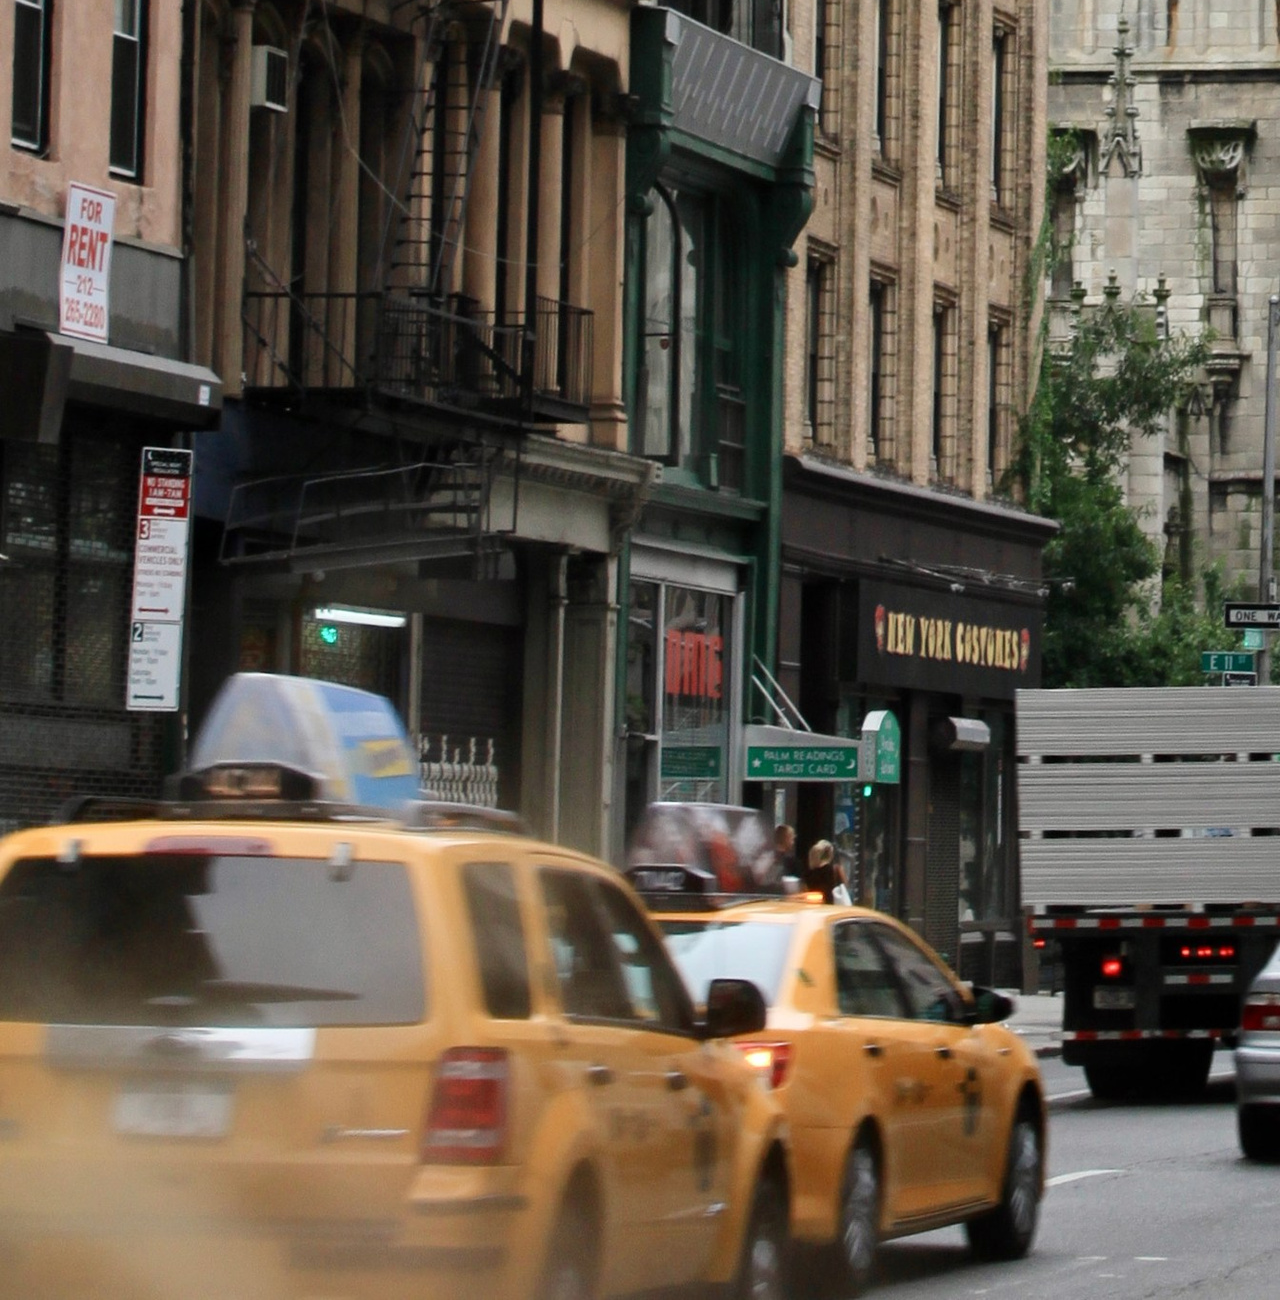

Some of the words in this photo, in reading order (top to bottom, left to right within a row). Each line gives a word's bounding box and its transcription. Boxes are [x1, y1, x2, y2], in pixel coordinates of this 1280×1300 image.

[80, 198, 103, 224] FOR
[67, 223, 108, 273] RENT
[76, 275, 93, 296] 212
[147, 477, 156, 487] NO
[157, 478, 185, 489] STANDING
[140, 520, 149, 539] 3
[139, 545, 177, 554] COMMERCIAL
[139, 556, 166, 565] VEHICLES
[168, 557, 183, 566] ONLY
[1236, 611, 1257, 622] ONE
[133, 623, 142, 641] 2
[887, 611, 915, 656] NEW
[918, 616, 952, 662] YORK
[955, 622, 1019, 670] COSTUMES
[1210, 655, 1218, 670] E
[1224, 655, 1233, 670] 11
[764, 750, 790, 760] PALM
[793, 750, 845, 761] READINGS
[773, 763, 804, 774] TAROT
[808, 764, 837, 774] CARD
